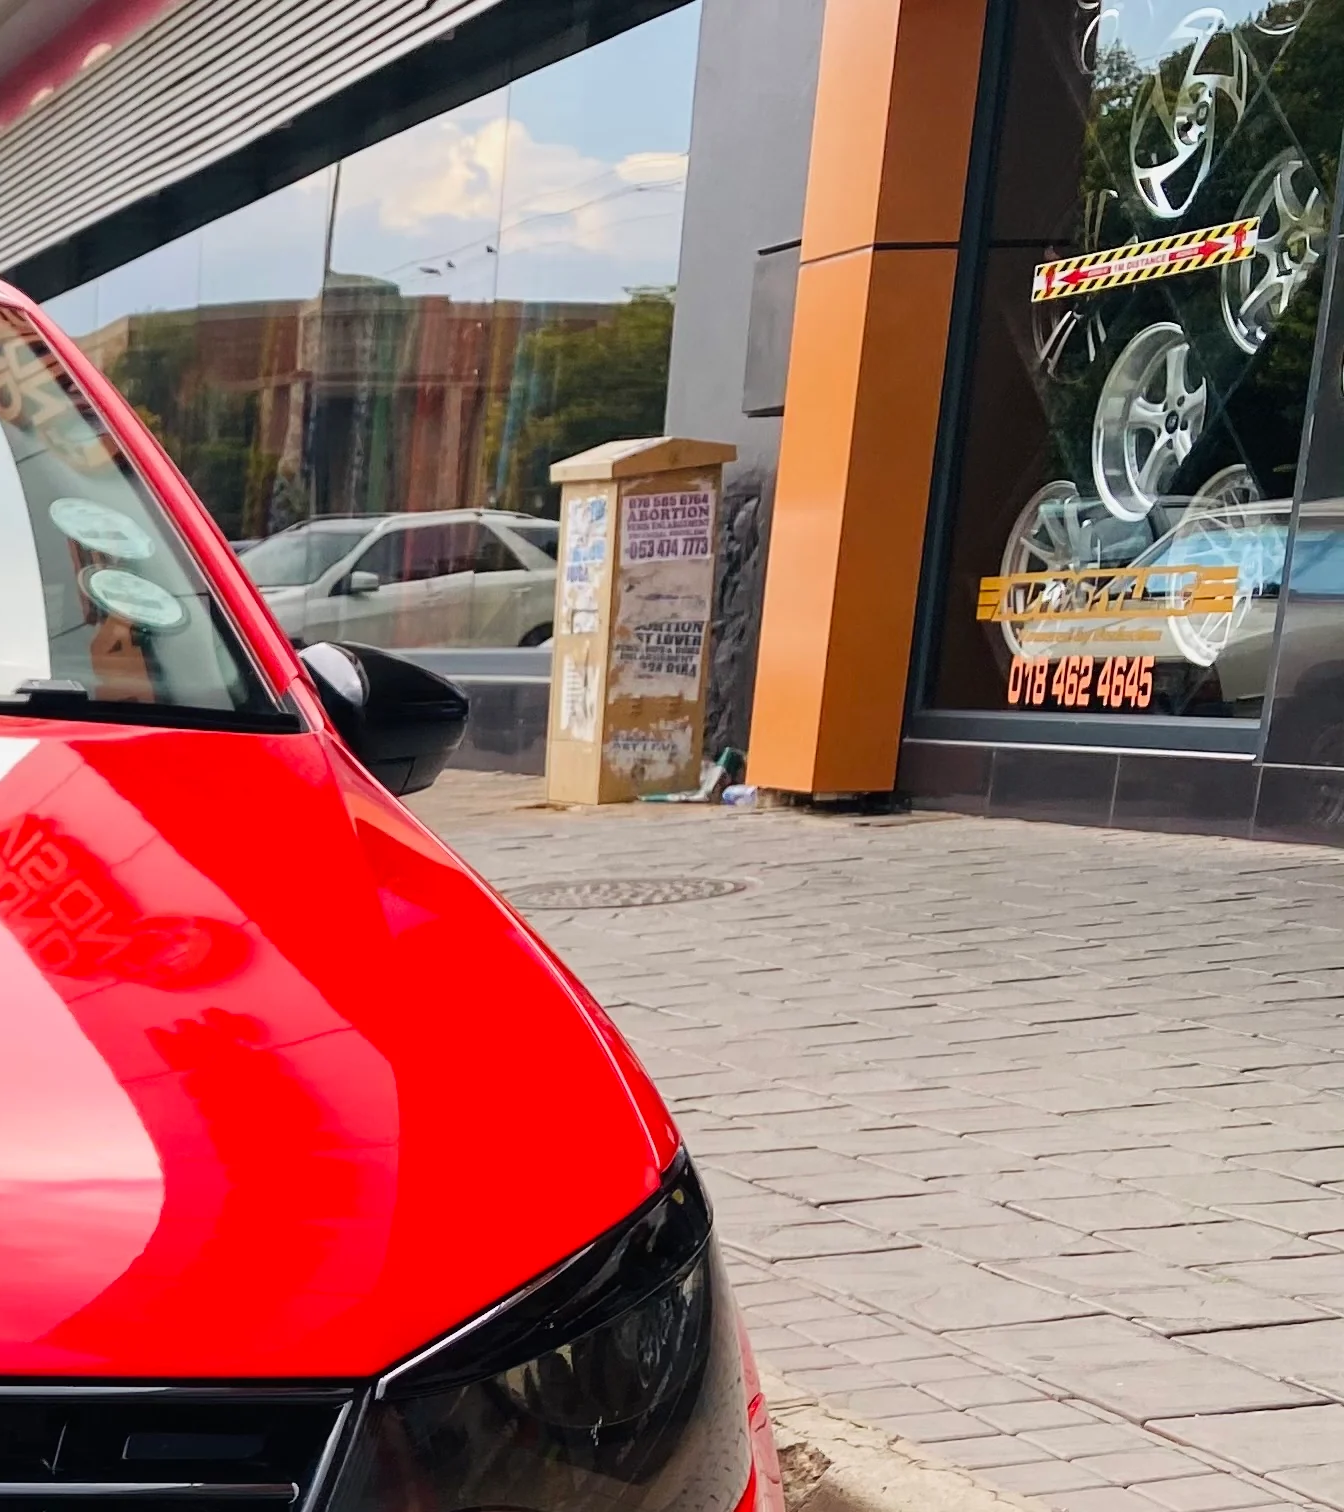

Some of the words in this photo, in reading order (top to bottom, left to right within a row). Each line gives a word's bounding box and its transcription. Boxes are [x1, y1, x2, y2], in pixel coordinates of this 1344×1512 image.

[1126, 253, 1167, 270] DISTANCE
[627, 505, 710, 521] ABORTION
[1007, 654, 1050, 706] 018
[1051, 654, 1094, 707] 462
[1097, 654, 1156, 708] 4645
